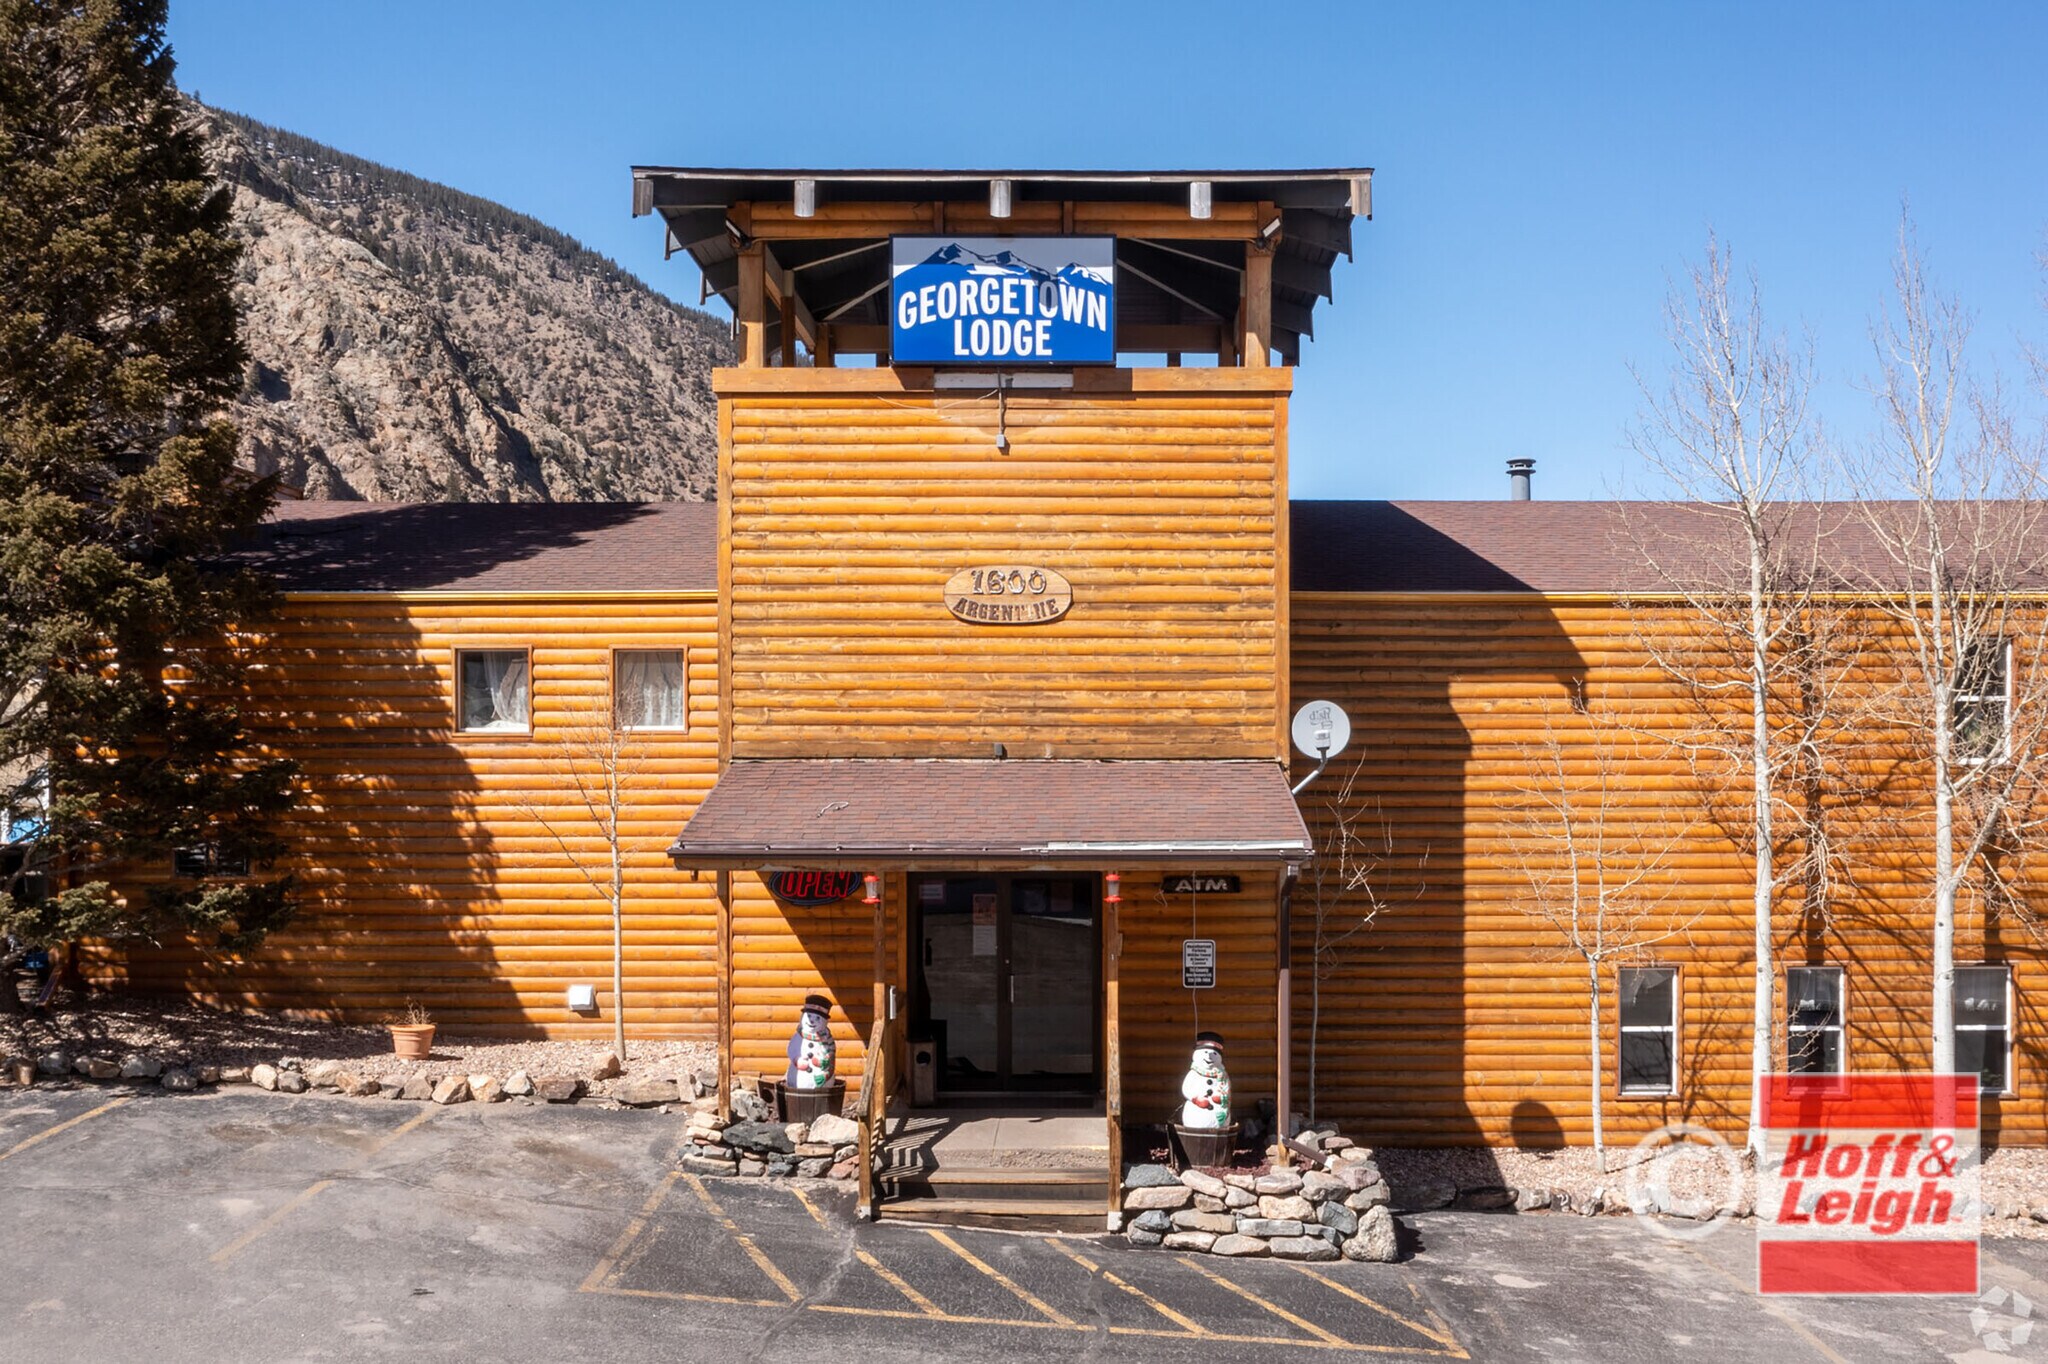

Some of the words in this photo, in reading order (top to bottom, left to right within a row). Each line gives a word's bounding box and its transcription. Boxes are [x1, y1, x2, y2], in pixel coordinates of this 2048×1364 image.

[898, 277, 1106, 332] GEORGETOWN
[954, 319, 1053, 356] LODGE
[971, 569, 1046, 594] 1600
[780, 871, 850, 897] OPEN
[1175, 879, 1227, 891] ATM
